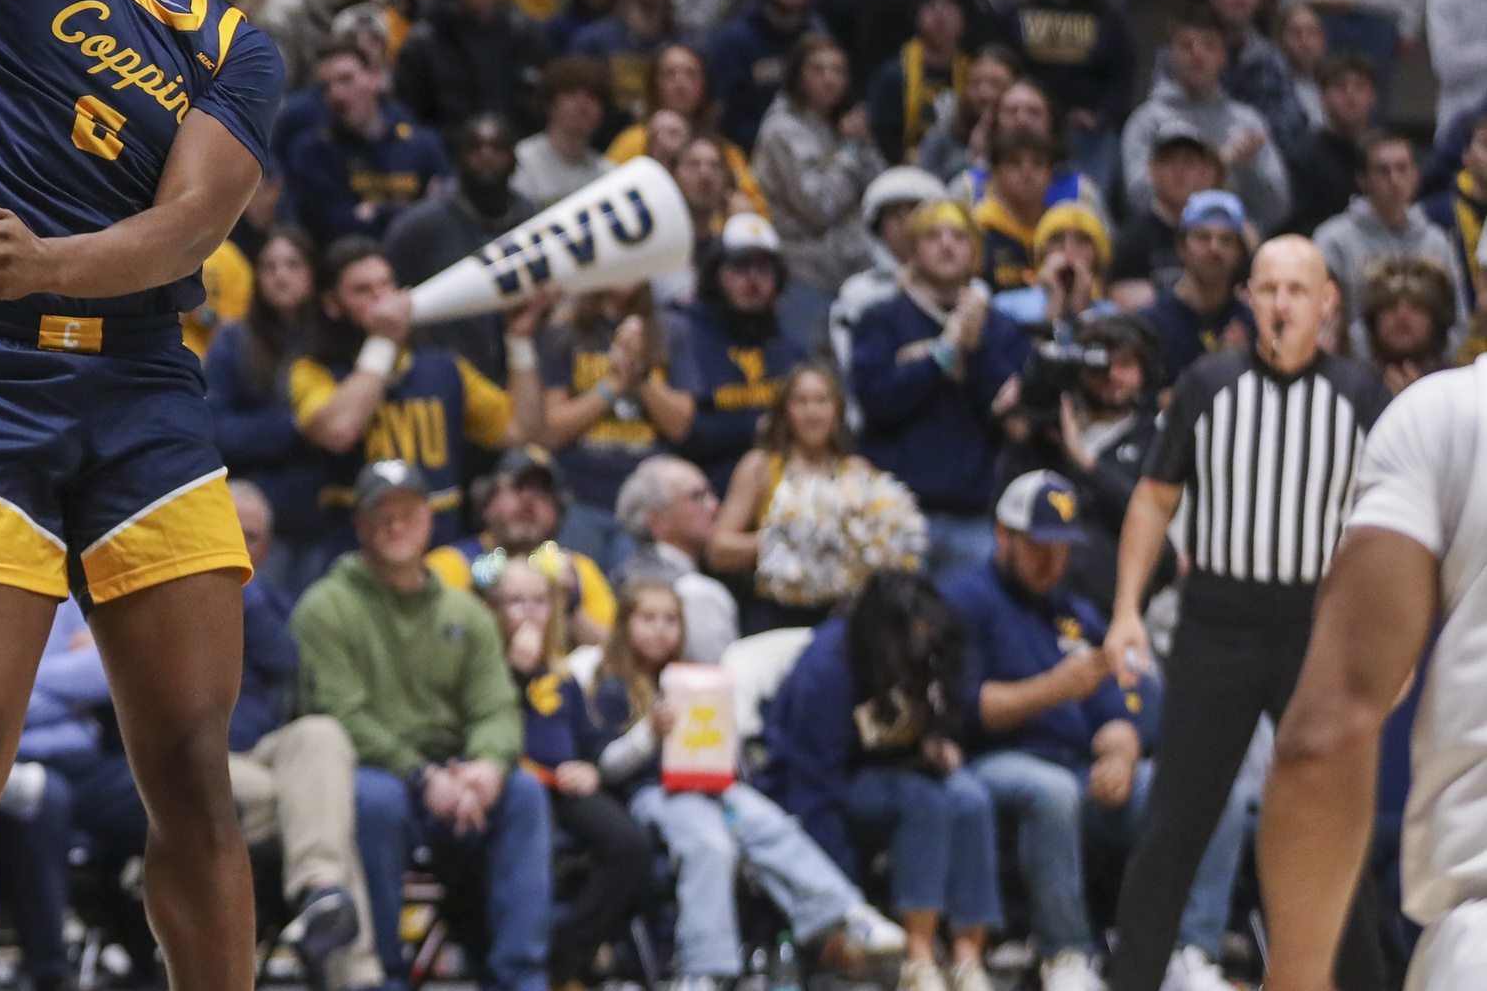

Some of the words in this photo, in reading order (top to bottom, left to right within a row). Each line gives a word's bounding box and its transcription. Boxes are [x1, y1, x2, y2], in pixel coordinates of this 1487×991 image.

[51, 0, 191, 126] Coppin
[477, 188, 654, 295] WVU
[62, 320, 81, 348] C
